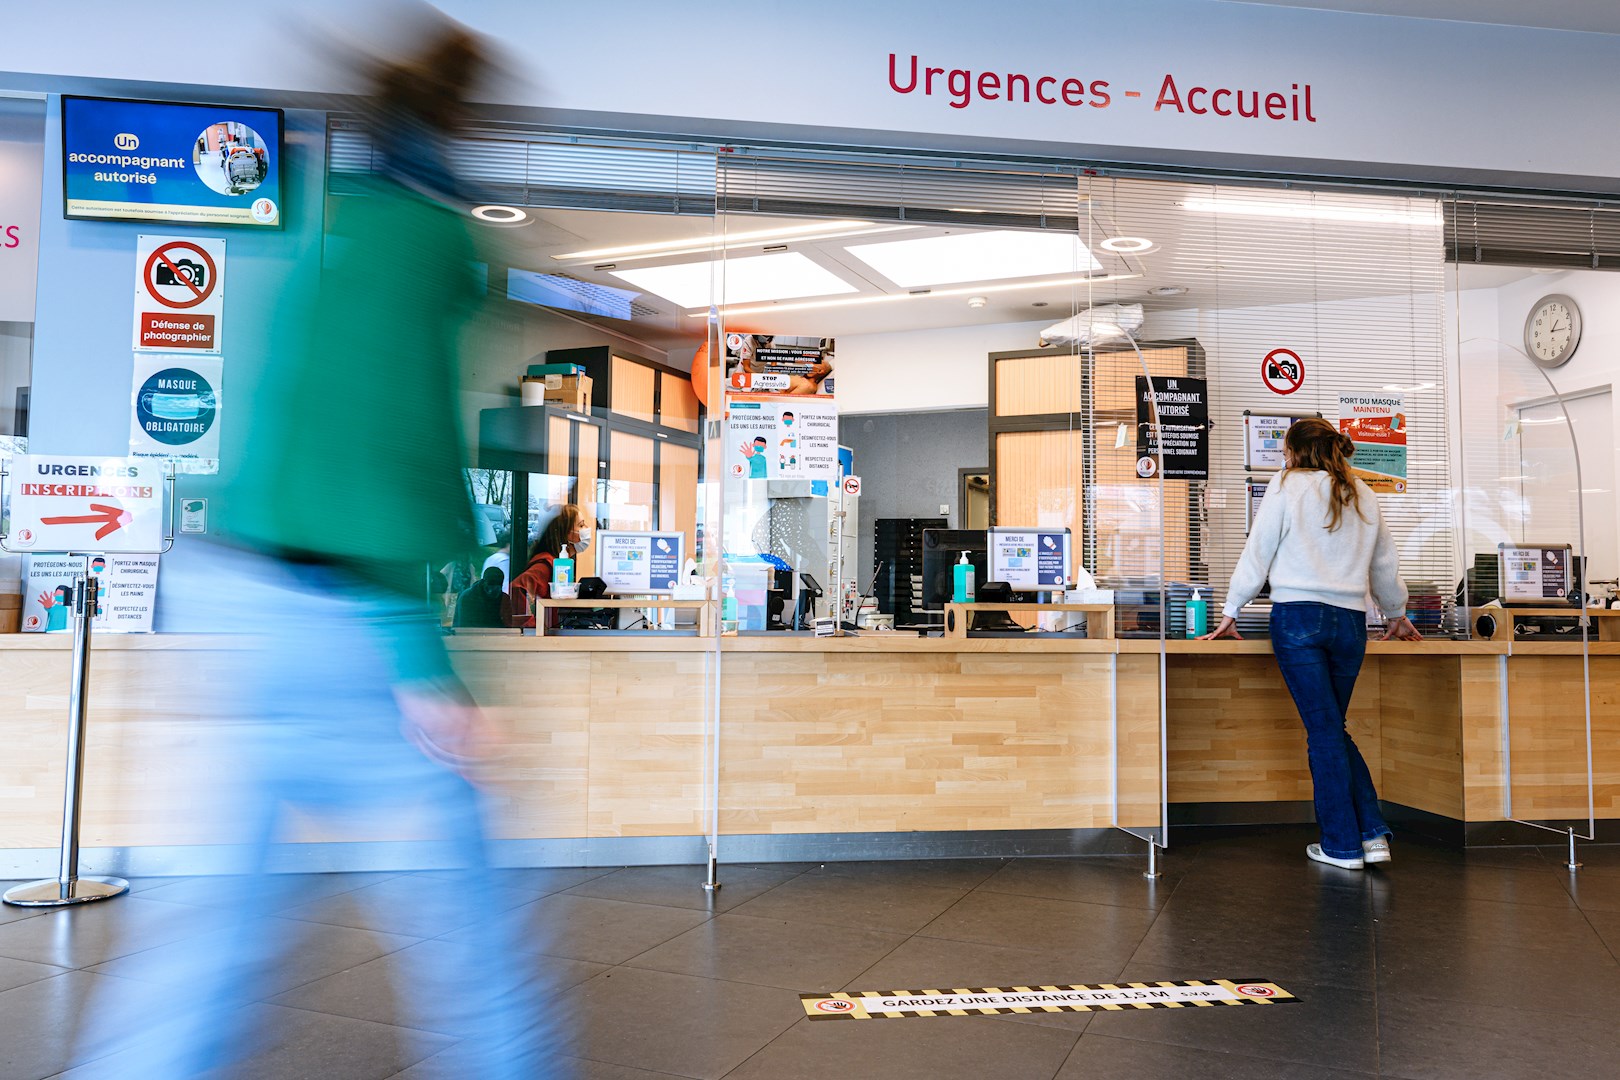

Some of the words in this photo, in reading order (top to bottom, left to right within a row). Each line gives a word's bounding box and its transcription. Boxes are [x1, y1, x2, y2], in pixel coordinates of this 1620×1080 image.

[889, 53, 1109, 109] Urgences
[1154, 74, 1317, 123] Accueil
[117, 136, 136, 147] Un
[69, 153, 185, 169] accompagnant
[94, 171, 157, 184] autorisé
[151, 320, 190, 330] Défense
[192, 322, 205, 330] de
[144, 331, 211, 342] photographier
[158, 379, 197, 390] MASQUE
[1167, 380, 1177, 388] UN
[1144, 392, 1200, 402] ACCOMPAGNANT
[1340, 397, 1358, 405] PORT
[1371, 398, 1401, 406] MASQUE
[1158, 405, 1189, 415] AUTORISÉ
[146, 422, 205, 433] OBLIGATOIRE
[883, 998, 957, 1007] GARDEZ
[960, 996, 999, 1004] UNE
[1003, 993, 1089, 1003] DISTANCE
[1120, 991, 1147, 999] 1,5
